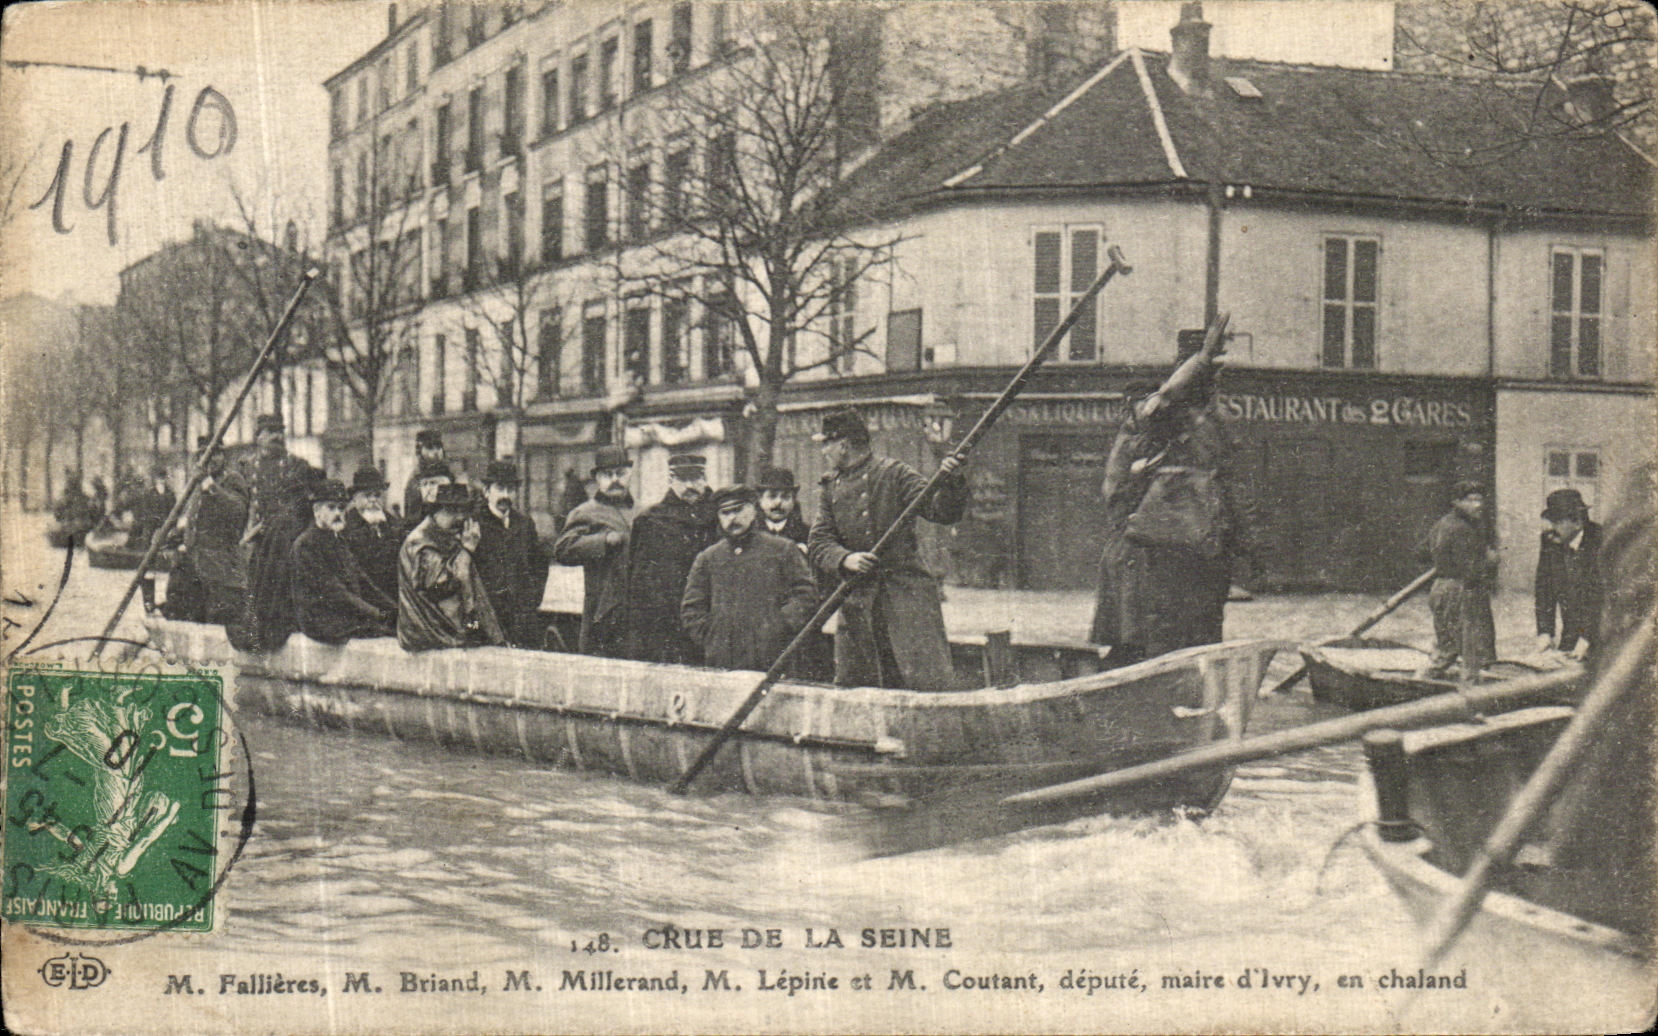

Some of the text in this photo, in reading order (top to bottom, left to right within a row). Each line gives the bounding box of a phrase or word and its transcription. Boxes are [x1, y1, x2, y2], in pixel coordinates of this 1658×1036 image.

[28, 83, 239, 247] 1910
[1215, 394, 1341, 423] ESTAURANT
[1369, 398, 1390, 425] 2
[1391, 396, 1472, 427] GARES
[12, 684, 35, 769] POSTES
